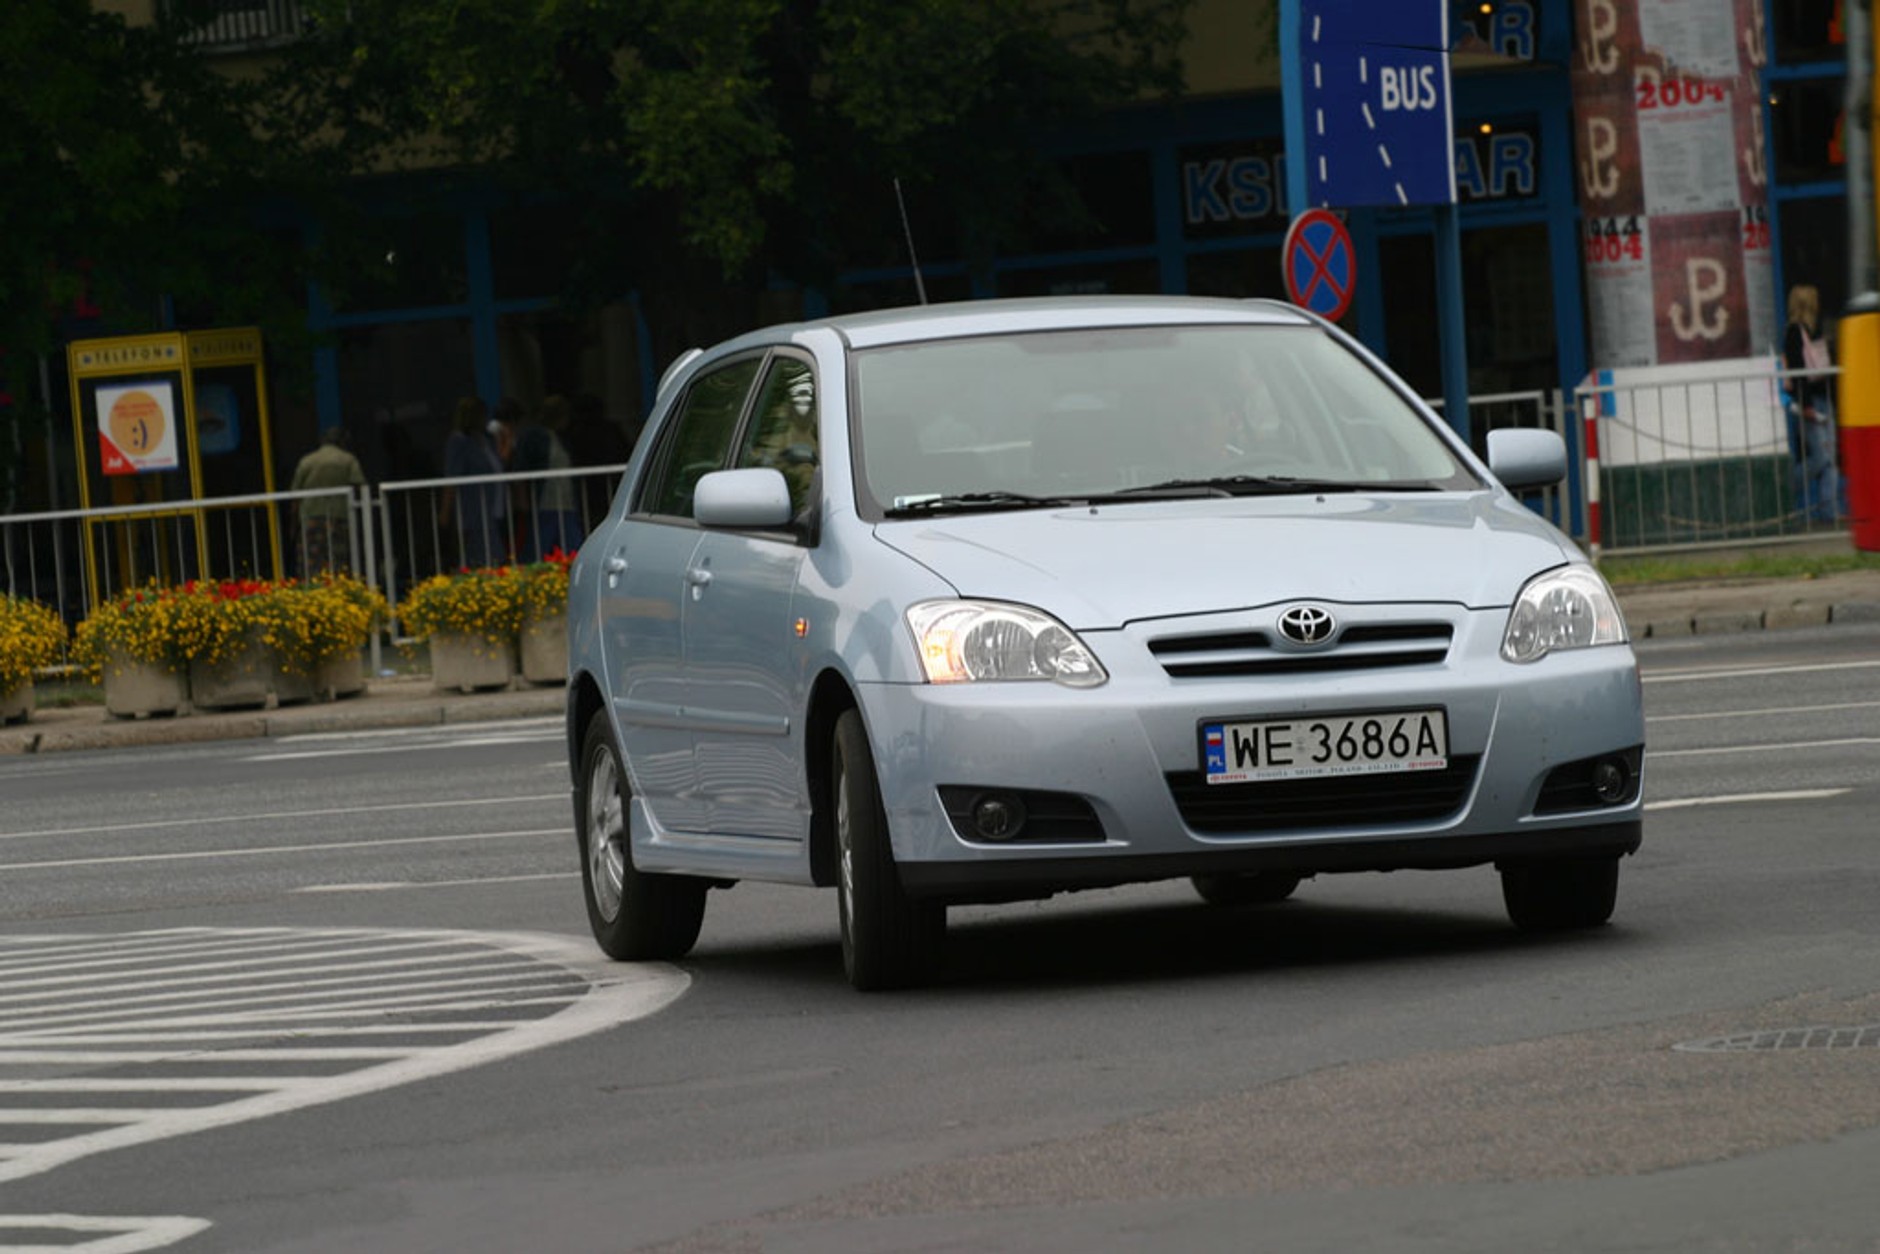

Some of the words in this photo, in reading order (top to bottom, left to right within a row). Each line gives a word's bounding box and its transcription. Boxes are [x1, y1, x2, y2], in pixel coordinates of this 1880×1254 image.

[1380, 65, 1437, 111] BUS
[95, 346, 162, 363] TELEFON
[1233, 725, 1293, 768] WE
[1310, 716, 1438, 763] 3686A
[1208, 755, 1223, 767] PL
